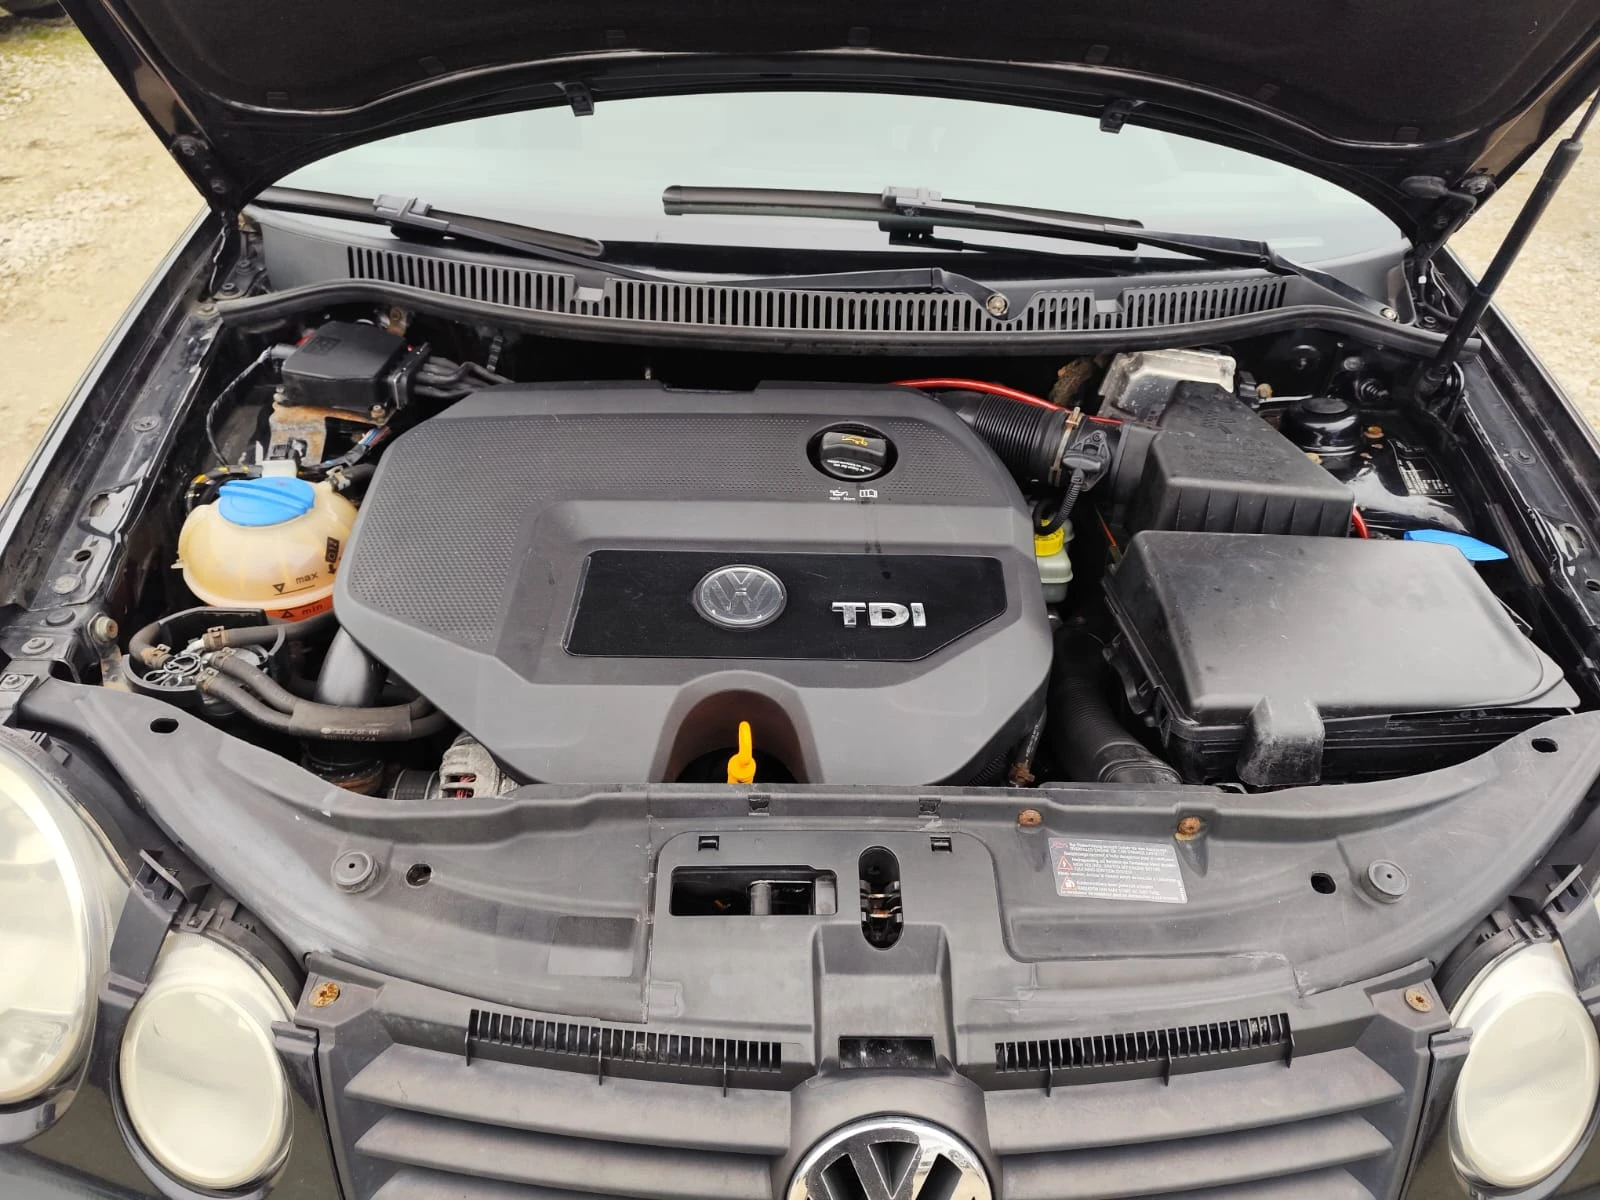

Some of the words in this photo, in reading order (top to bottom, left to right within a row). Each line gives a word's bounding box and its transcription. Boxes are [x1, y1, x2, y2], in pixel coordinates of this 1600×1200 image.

[296, 572, 318, 584] max
[302, 604, 323, 615] min
[832, 602, 926, 627] TDI
